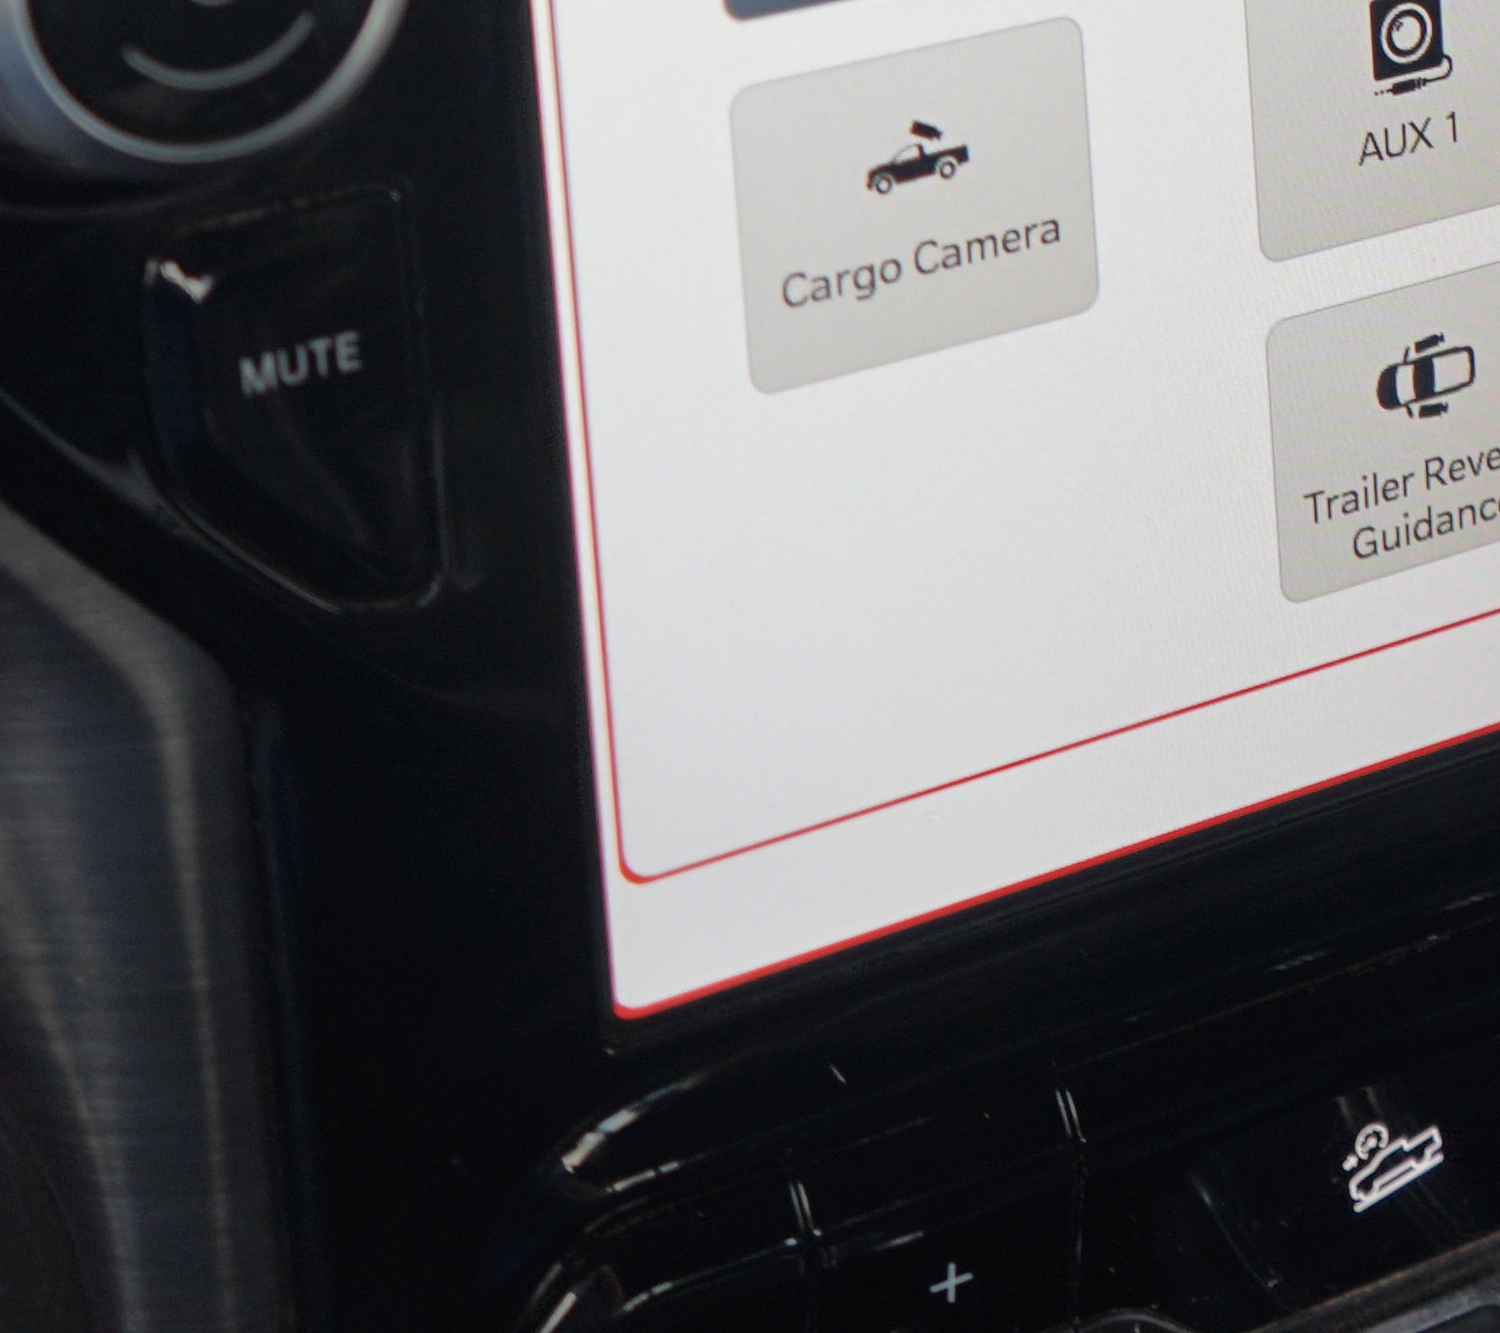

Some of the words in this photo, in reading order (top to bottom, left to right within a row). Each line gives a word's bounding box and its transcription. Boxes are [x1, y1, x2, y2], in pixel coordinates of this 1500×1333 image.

[1358, 119, 1431, 166] AUX
[1445, 111, 1460, 144] 1
[781, 257, 902, 309] Cargo
[912, 216, 1062, 275] Camera
[239, 332, 362, 396] MUTE
[1304, 471, 1414, 524] Trailer
